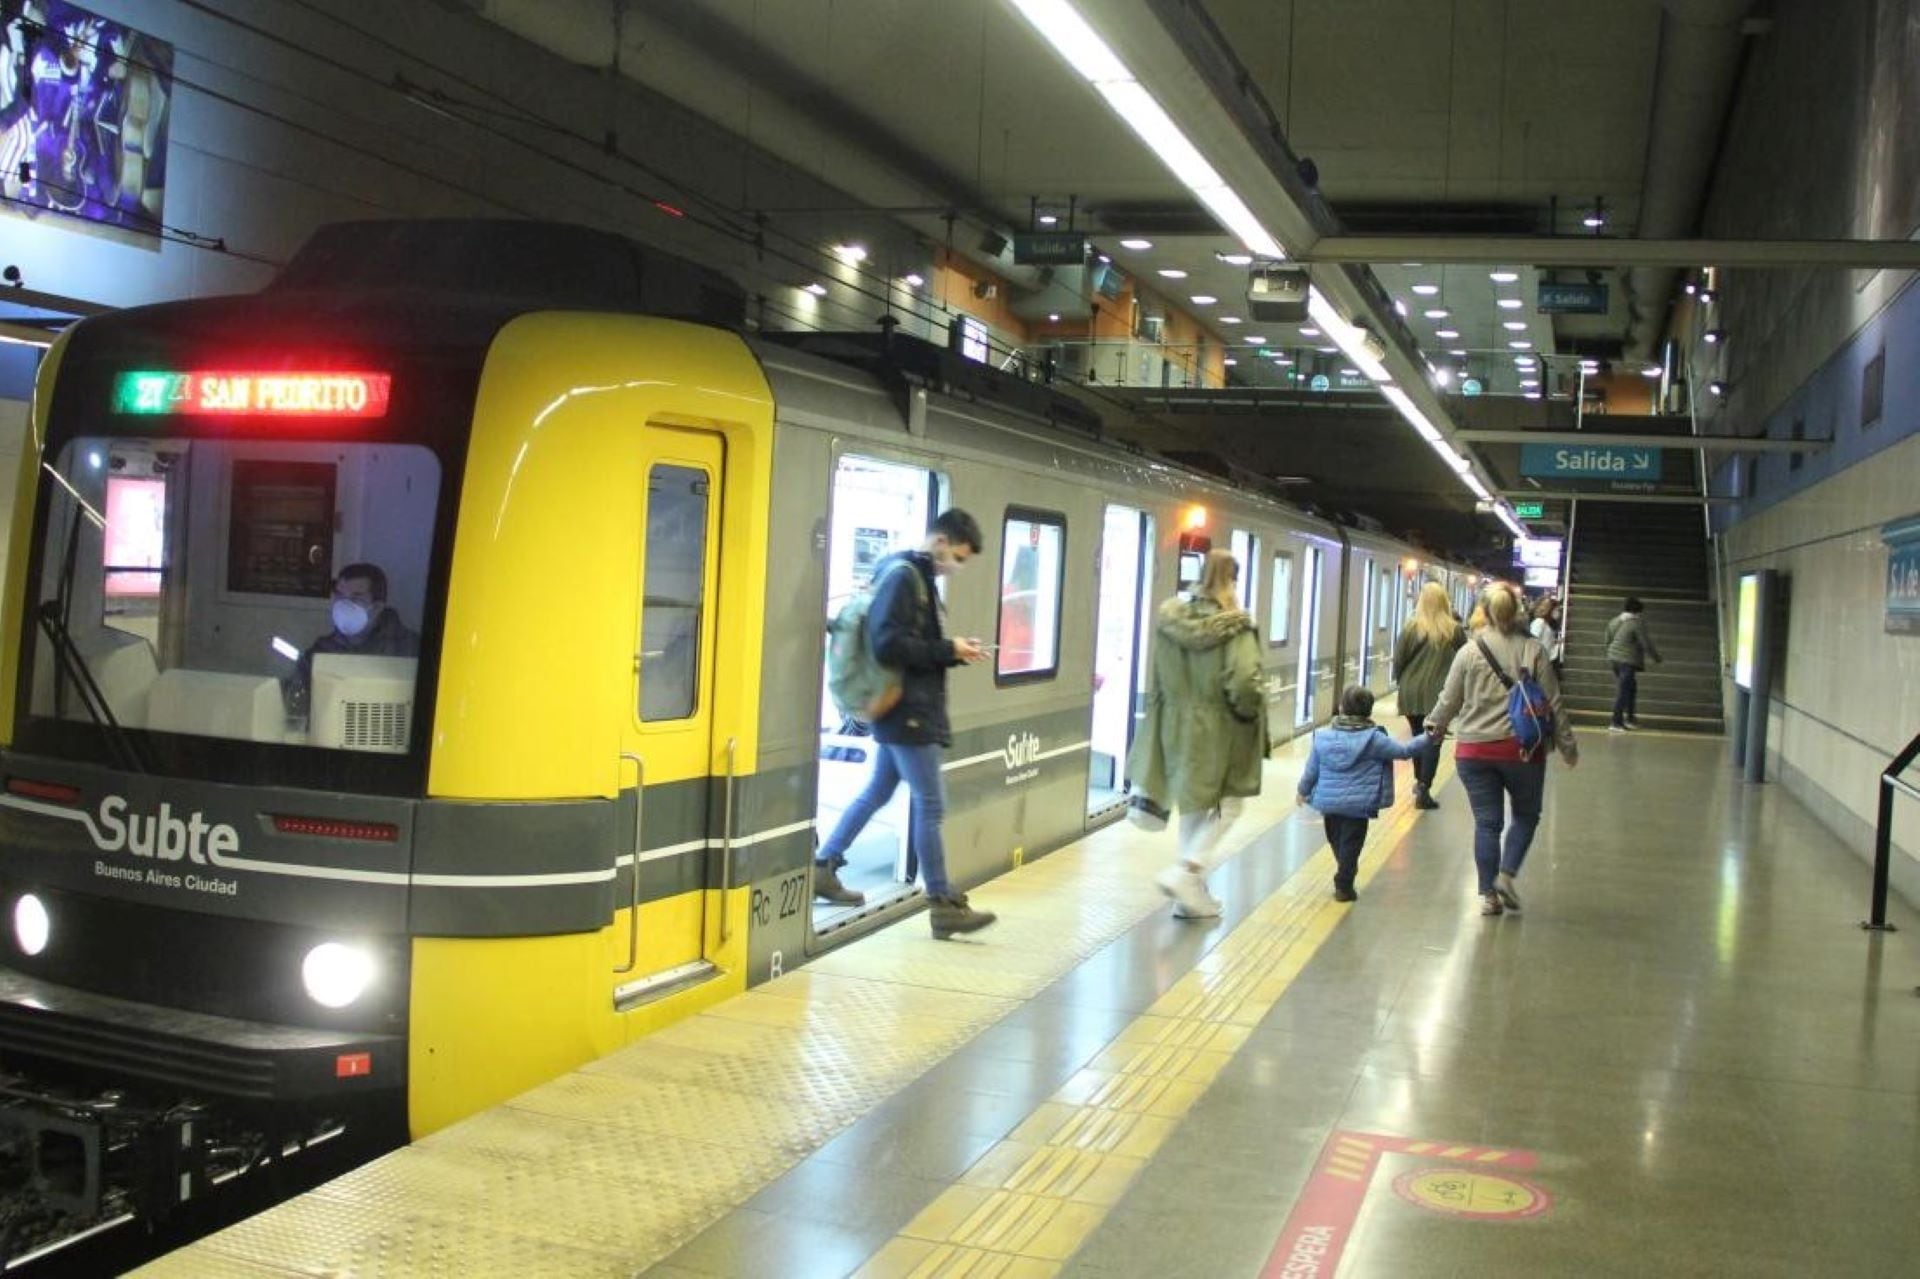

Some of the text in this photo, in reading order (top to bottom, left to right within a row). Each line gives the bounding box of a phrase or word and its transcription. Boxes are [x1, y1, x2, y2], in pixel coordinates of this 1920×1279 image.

[200, 377, 250, 410] SAN
[256, 378, 367, 412] PEDRITO
[1555, 450, 1625, 472] Salida
[99, 796, 239, 866] Subte
[94, 860, 237, 896] Buenos Aires Ciudad
[752, 874, 806, 928] Rc 227
